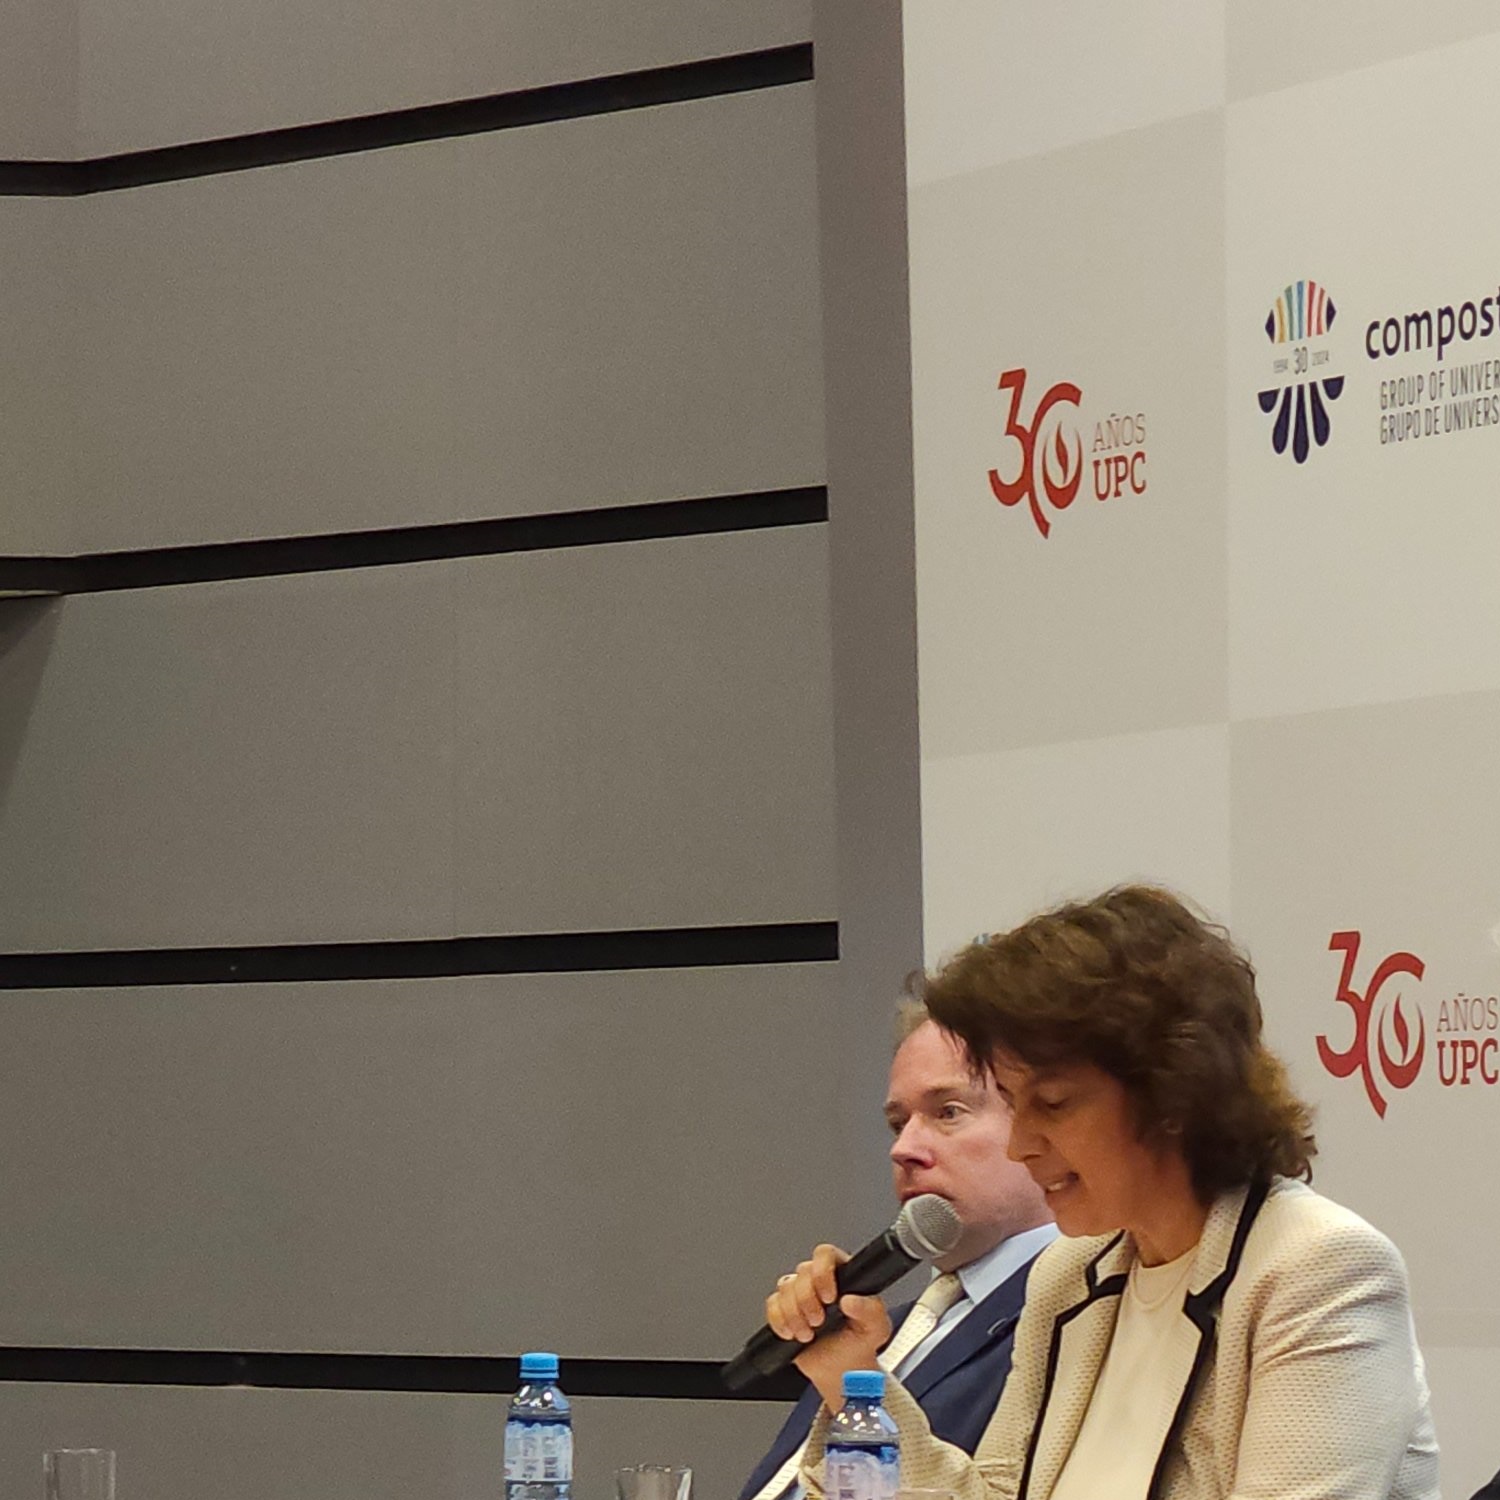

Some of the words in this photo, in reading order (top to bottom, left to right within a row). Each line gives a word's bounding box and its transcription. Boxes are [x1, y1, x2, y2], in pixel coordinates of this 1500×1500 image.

[1294, 346, 1308, 375] 30
[1379, 374, 1424, 410] GROUP
[1429, 370, 1445, 401] OF
[1092, 413, 1146, 453] AÑOS
[1379, 409, 1421, 445] GRUPO
[1424, 406, 1440, 437] DE
[988, 368, 1083, 539] 30
[1092, 451, 1147, 502] UPC
[1315, 930, 1426, 1121] 30
[1436, 993, 1499, 1033] AÑOS
[1436, 1037, 1500, 1087] UPC
